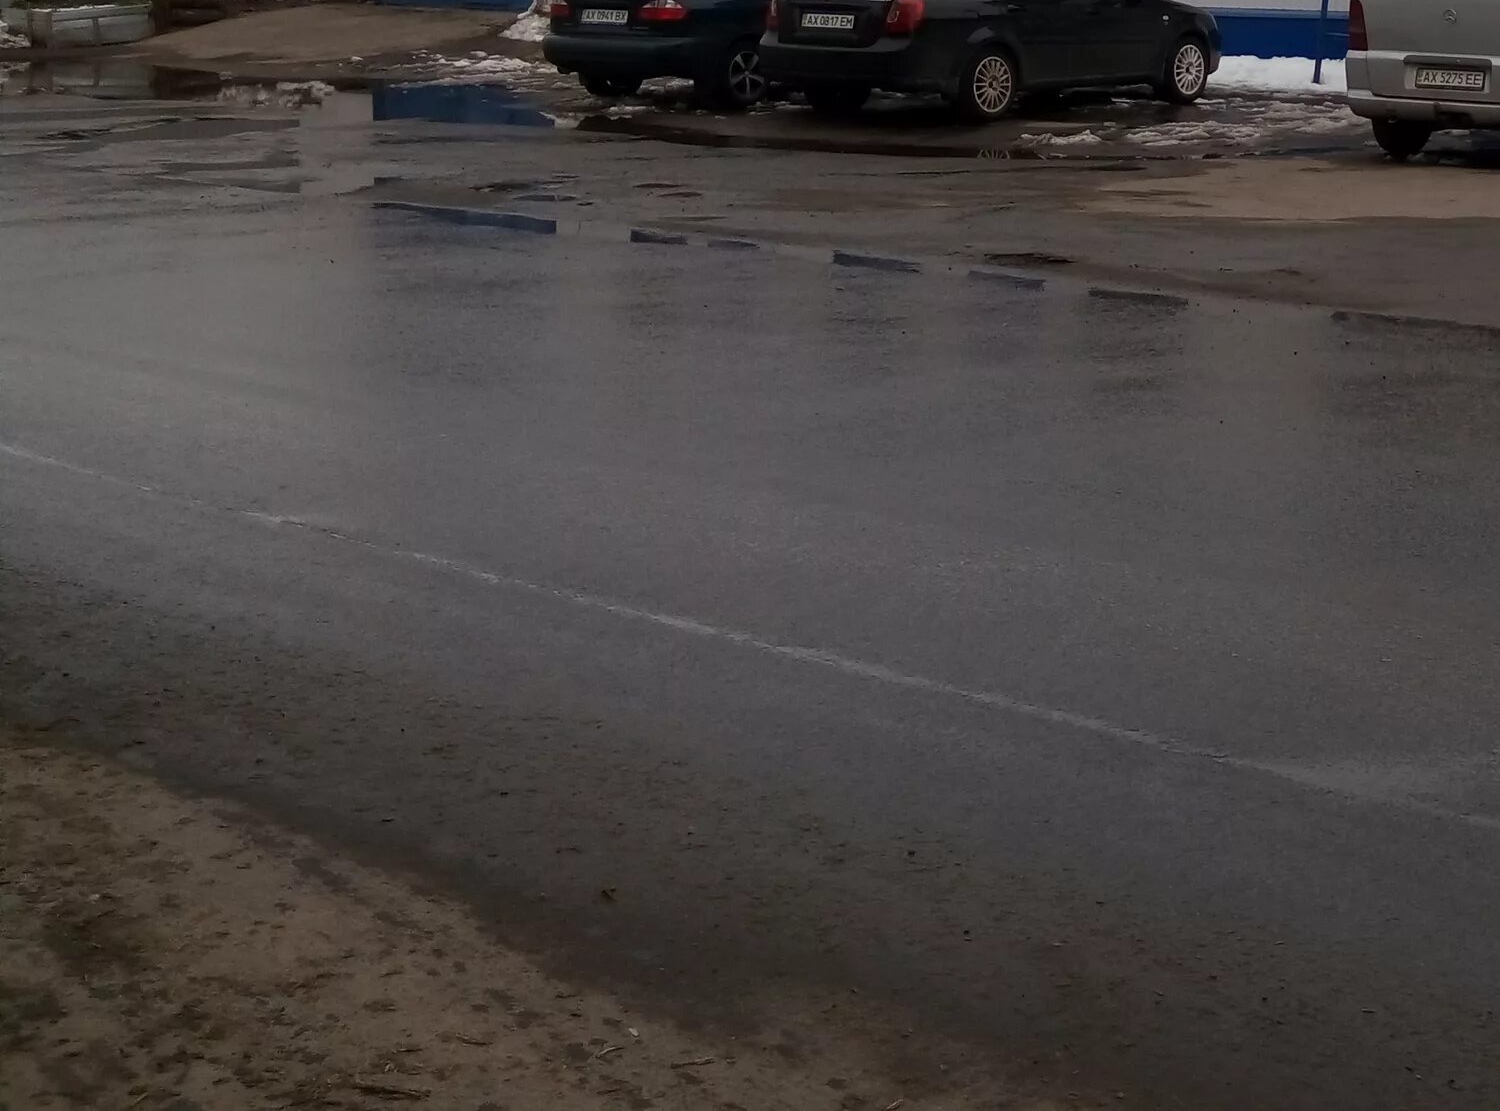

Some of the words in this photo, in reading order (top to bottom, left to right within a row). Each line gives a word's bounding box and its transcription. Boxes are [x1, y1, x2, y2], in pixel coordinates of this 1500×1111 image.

[586, 10, 595, 20] AX
[615, 11, 627, 21] BX
[807, 15, 819, 25] AX
[840, 17, 853, 27] EM
[1423, 71, 1437, 83] AX
[1440, 73, 1463, 84] 5275
[1465, 74, 1482, 86] EE
